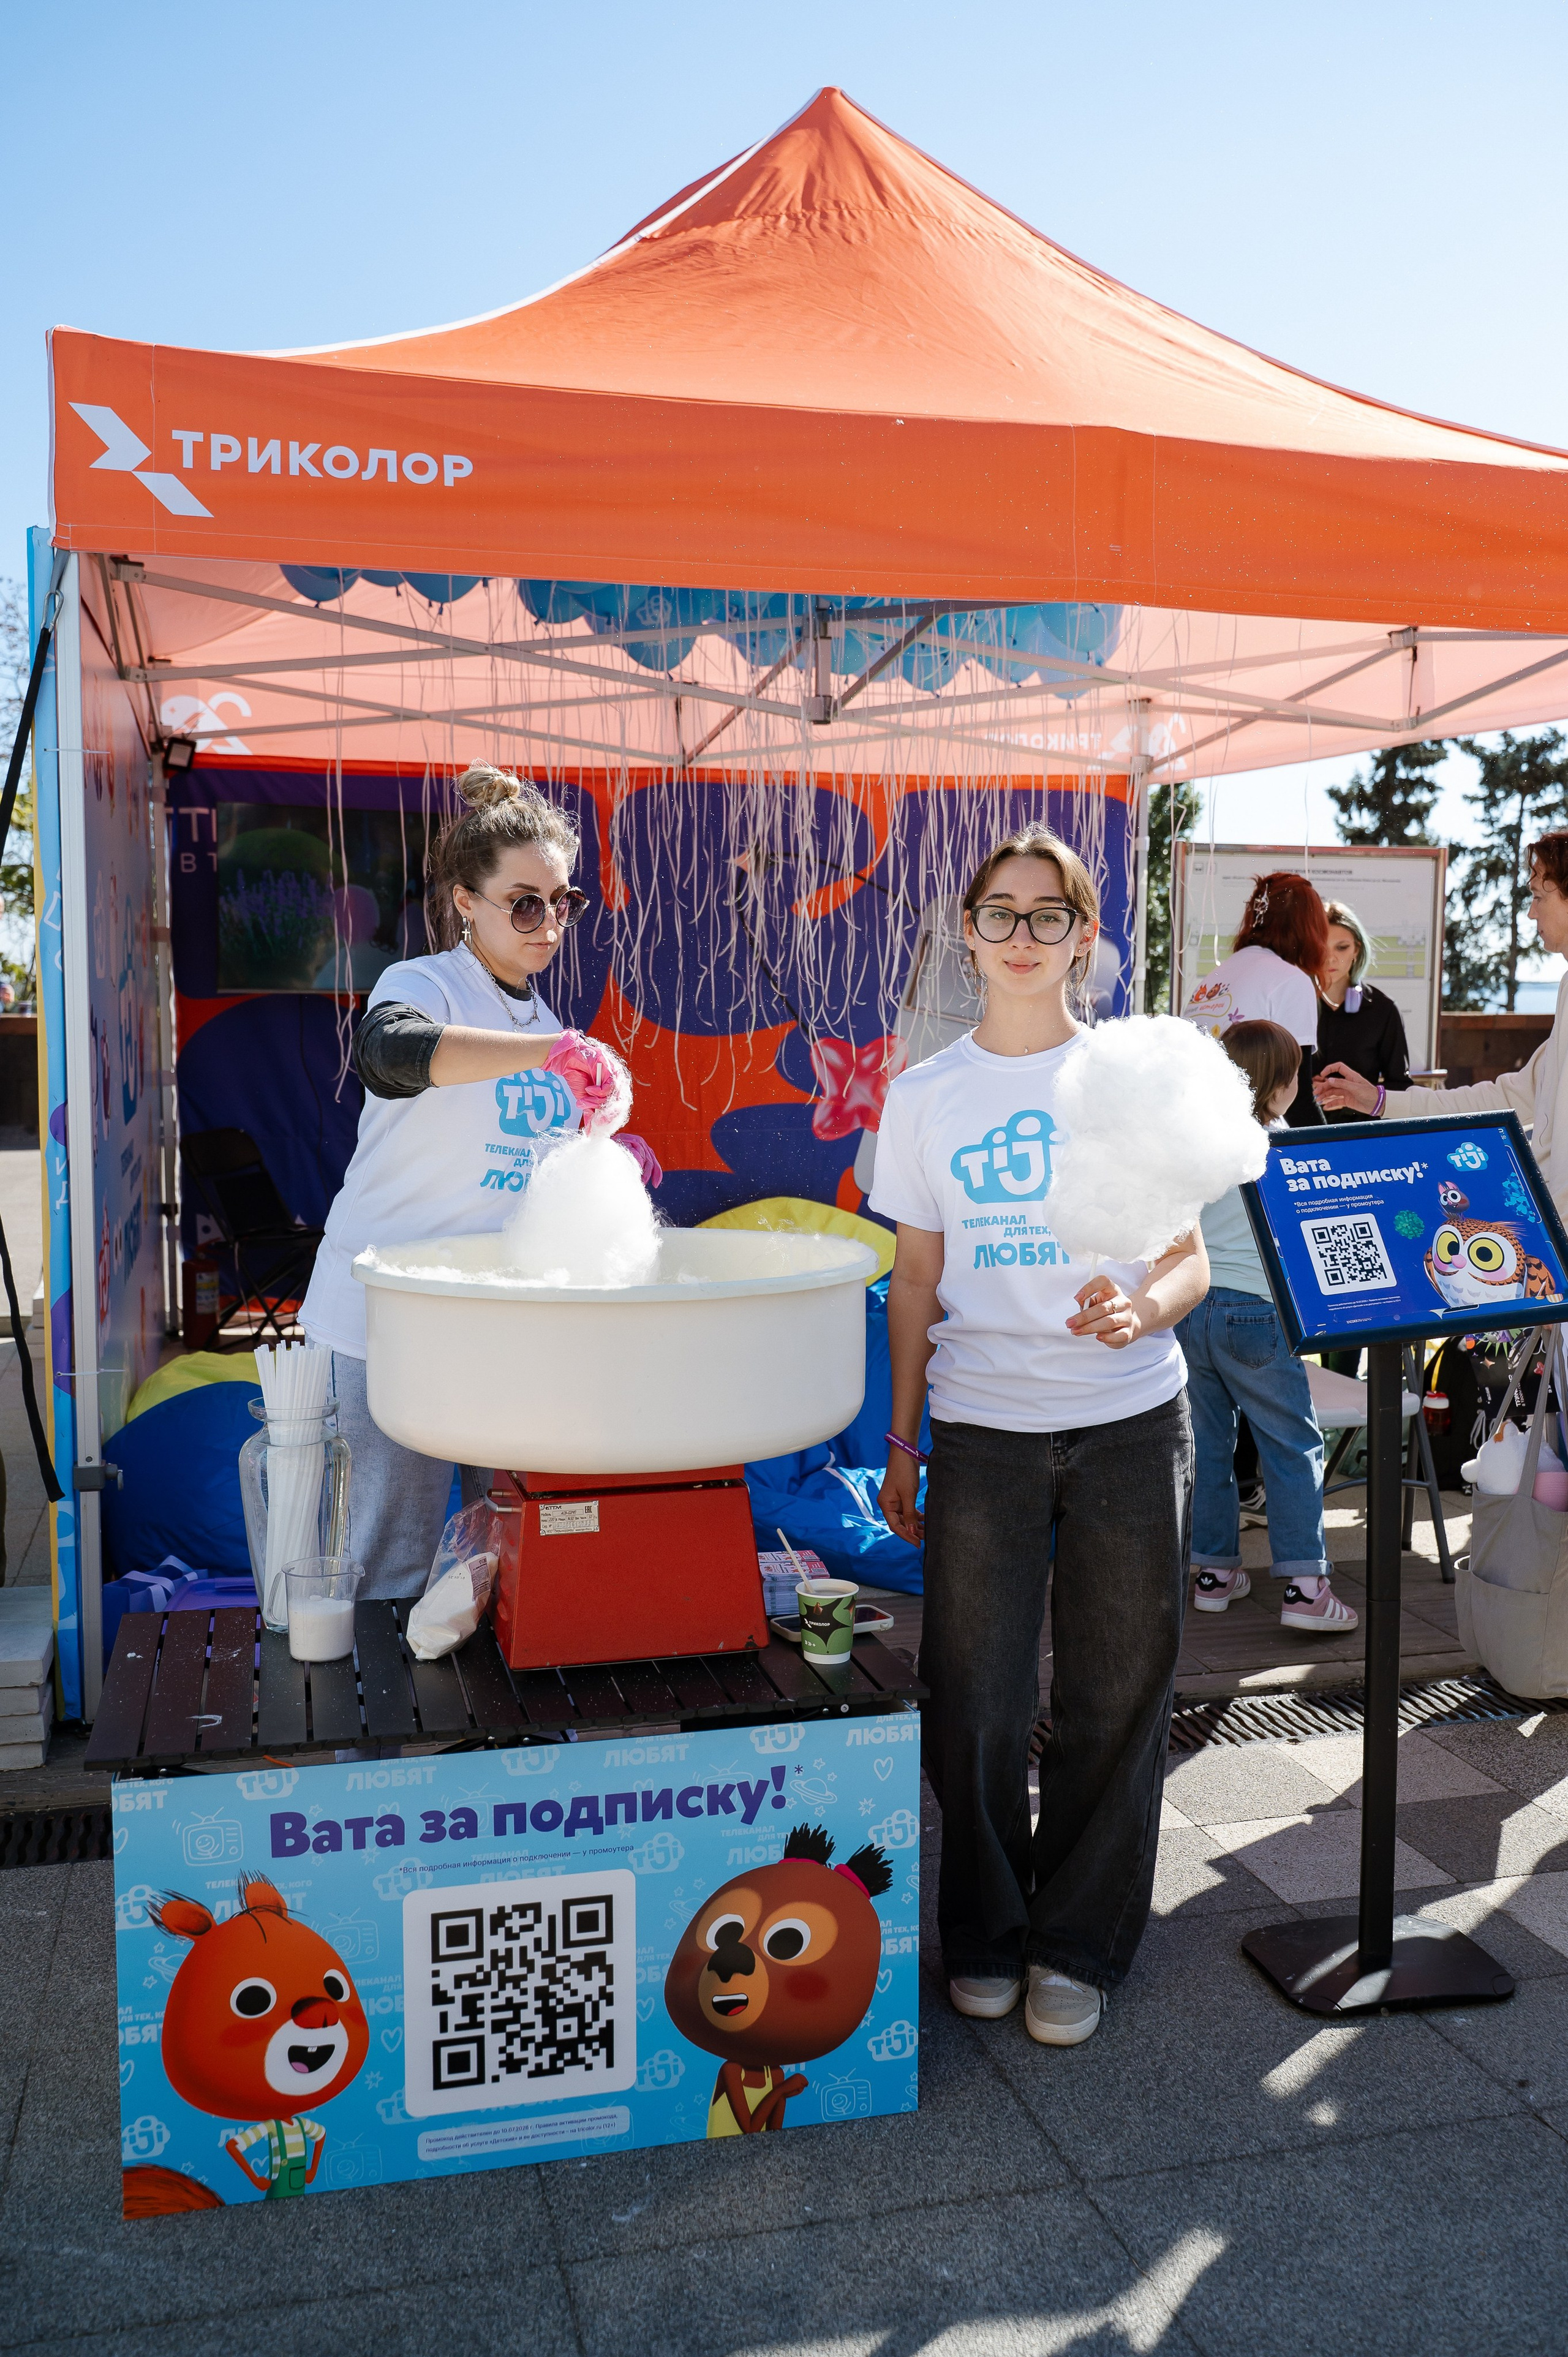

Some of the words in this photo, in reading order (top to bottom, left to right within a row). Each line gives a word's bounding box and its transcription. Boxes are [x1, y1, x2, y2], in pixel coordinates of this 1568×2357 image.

[172, 429, 473, 487] ТРИКОЛОР
[1279, 1158, 1332, 1175] Вата
[1286, 1177, 1311, 1192] за
[1301, 1204, 1339, 1214] подключении
[1351, 1199, 1384, 1209] промоутера
[1308, 1197, 1338, 1206] подробная
[962, 1215, 1026, 1229] ТЕЛЕКАНАЛ
[1003, 1227, 1027, 1237] ДЛЯ
[1029, 1226, 1051, 1236] ТЕХ,
[603, 1744, 689, 1768] ЛЮБЯТ
[346, 1766, 437, 1792] ЛЮБЯТ
[113, 1790, 168, 1812] БЯТ
[270, 1811, 405, 1858] Вата
[419, 1805, 478, 1844] за
[720, 1825, 775, 1836] ТЕЛЕКАНАЛ
[757, 1833, 775, 1841] ДЛЯ
[419, 1862, 461, 1872] подробная
[463, 1857, 511, 1868] информация
[519, 1852, 571, 1862] подключении
[589, 1845, 634, 1855] промоутера
[726, 1844, 785, 1866] ЛЮБ
[426, 2135, 453, 2144] Промокод
[559, 2118, 587, 2126] активации
[426, 2144, 461, 2153] подробности
[470, 2140, 488, 2148] услуге
[531, 2130, 565, 2139] доступности
